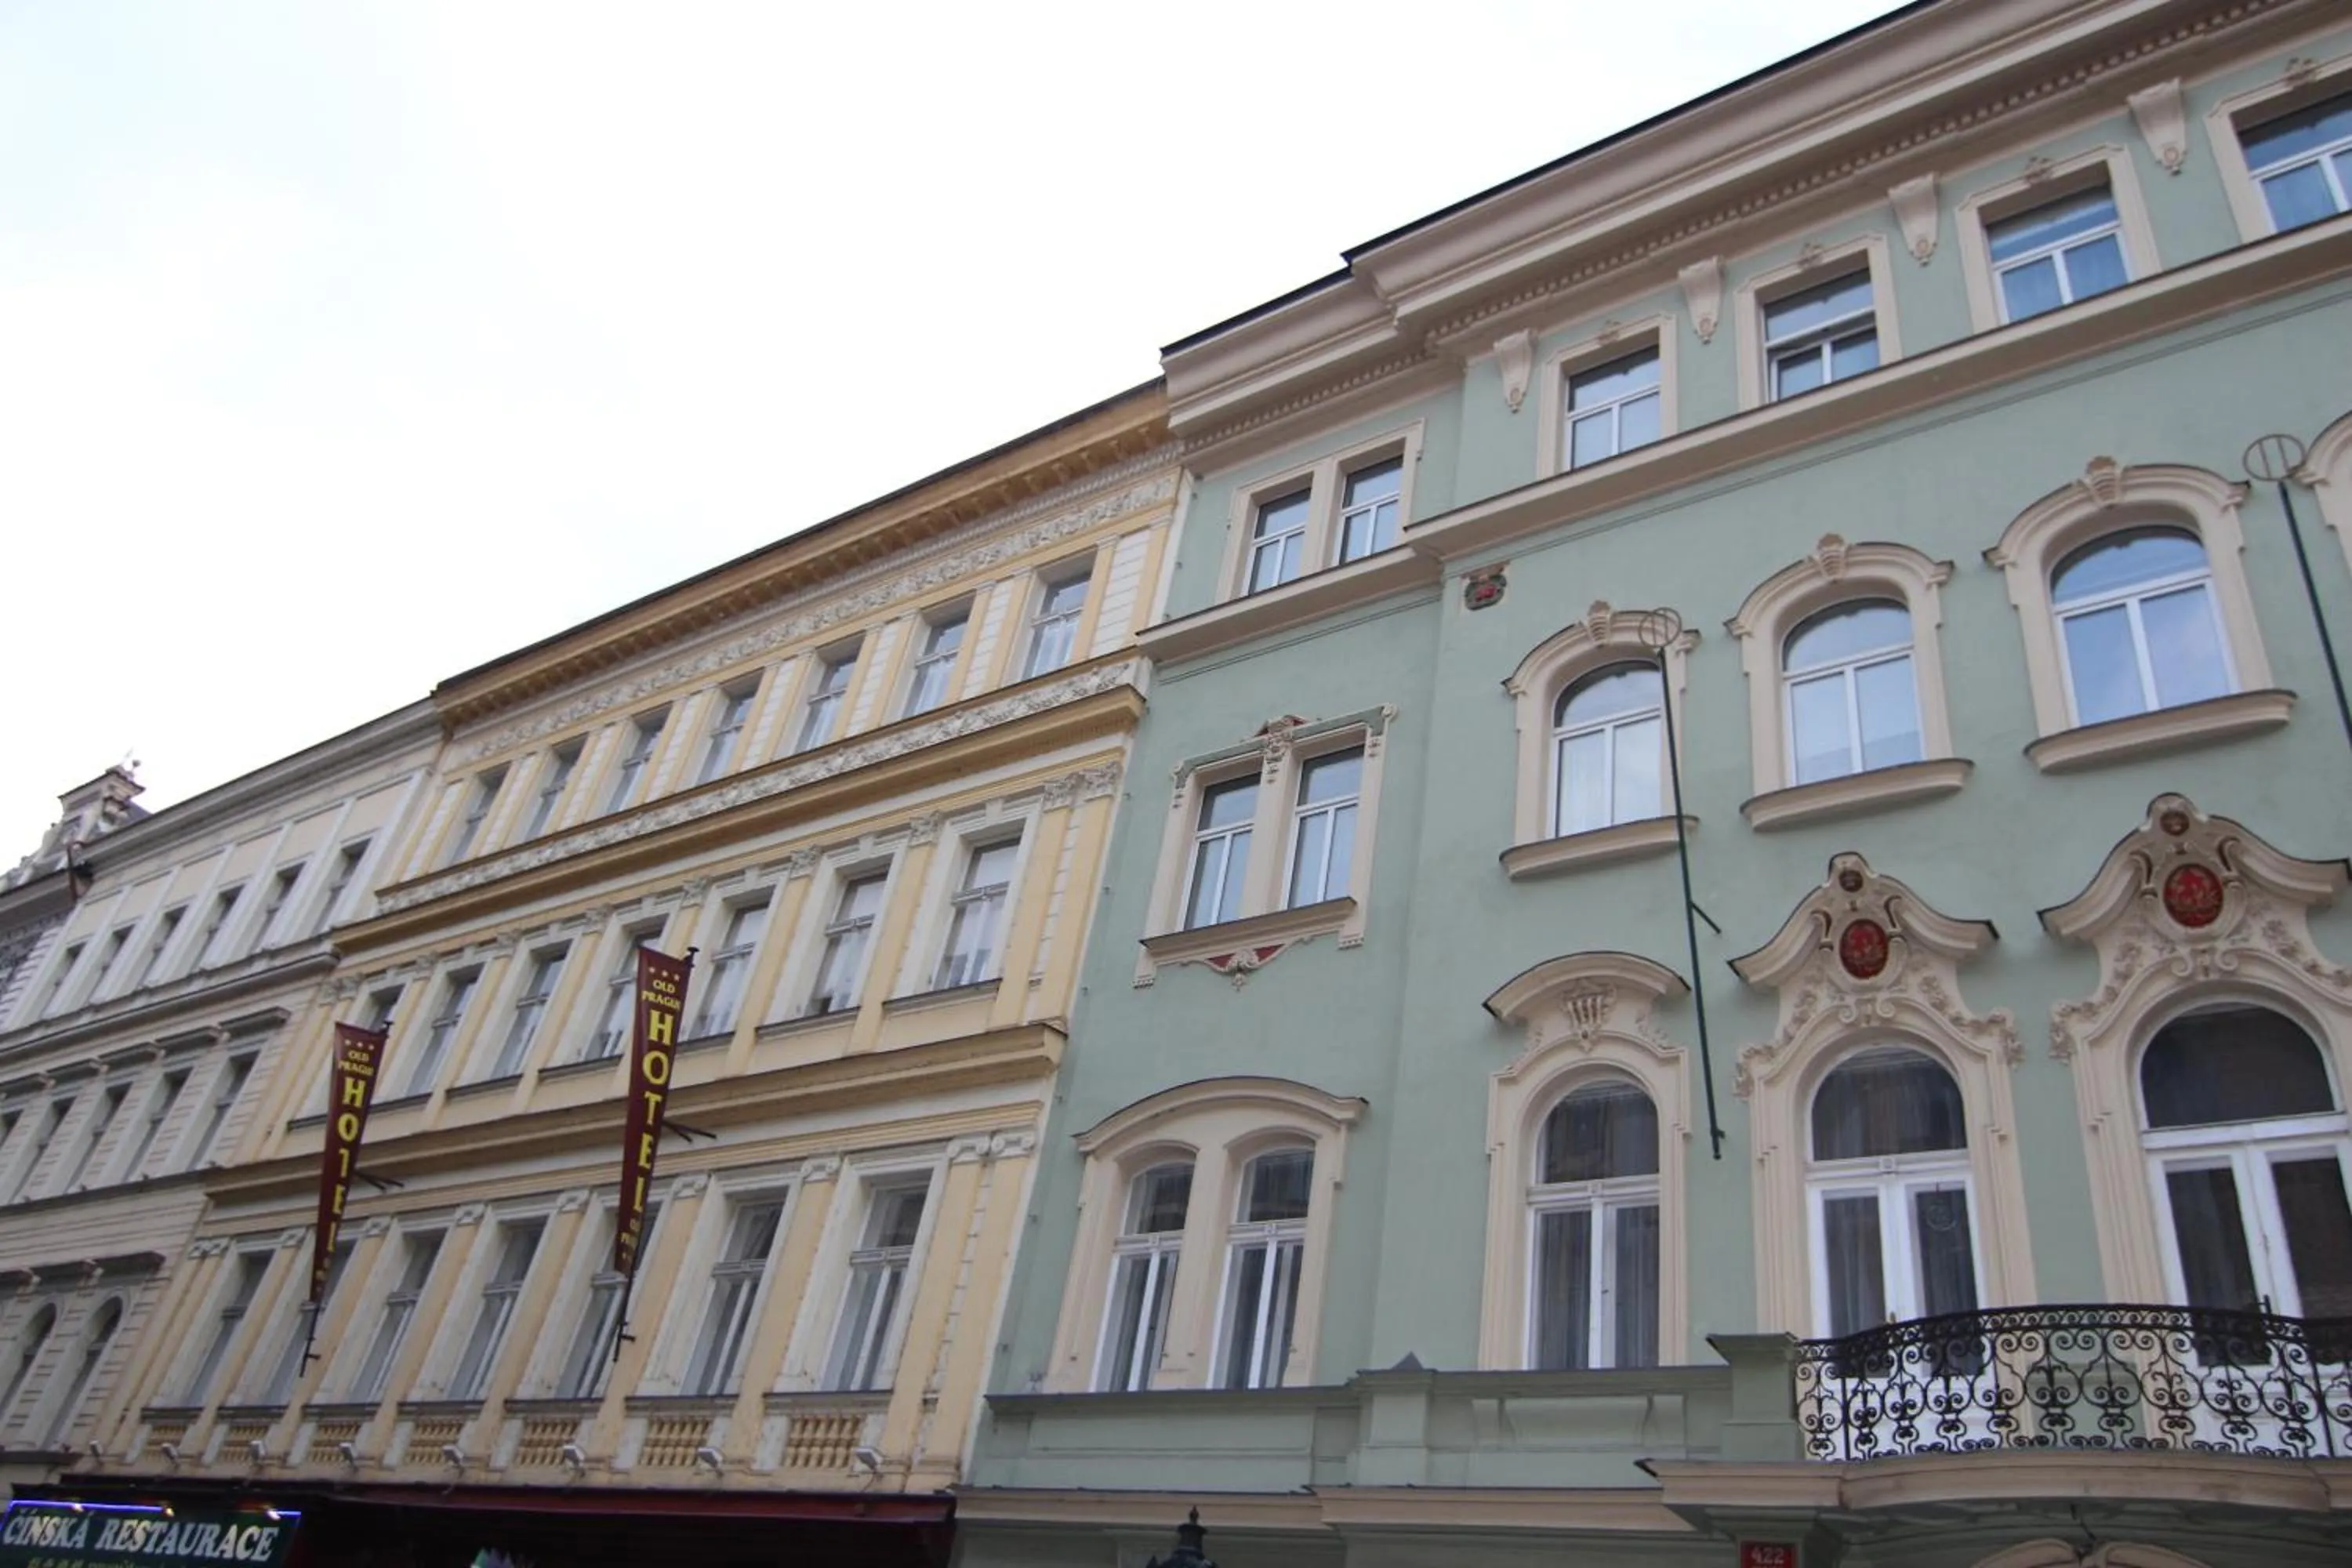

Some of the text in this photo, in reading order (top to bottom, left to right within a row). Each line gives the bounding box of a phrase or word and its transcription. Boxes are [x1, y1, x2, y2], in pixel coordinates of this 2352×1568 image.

[652, 979, 676, 995] OLD
[348, 1051, 369, 1062] OLD
[338, 1059, 374, 1076] PRAGU
[633, 1008, 674, 1214] HOTEL
[327, 1076, 365, 1252] HOTEL
[2, 1508, 280, 1562] ČÍNSKÁ RESTAURACE
[1751, 1545, 1785, 1565] 422
